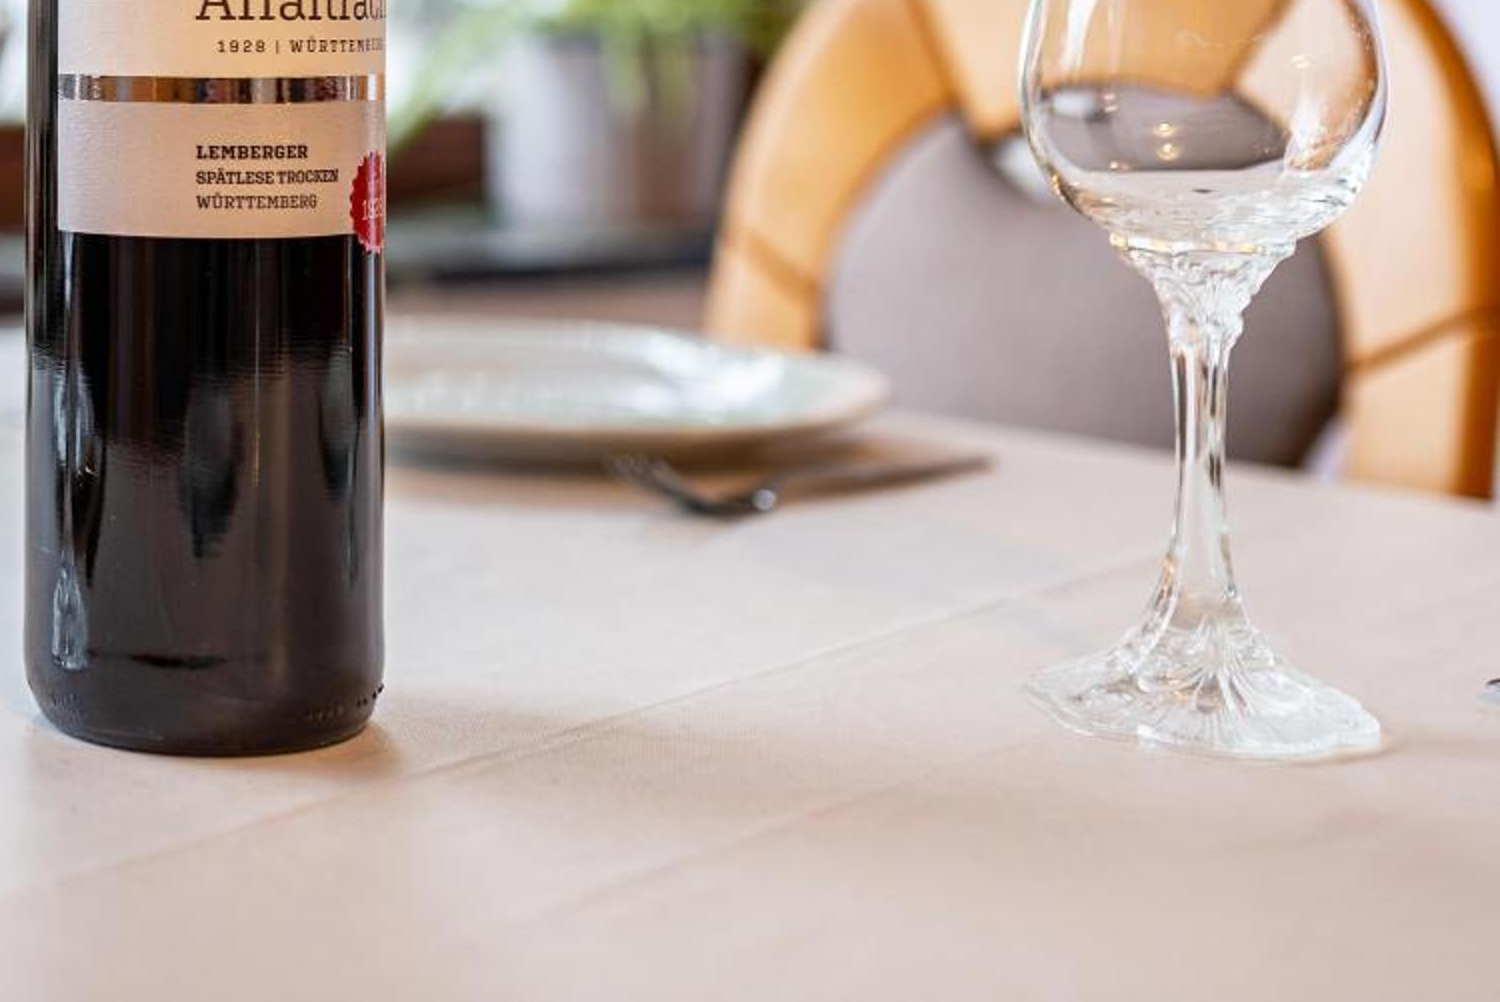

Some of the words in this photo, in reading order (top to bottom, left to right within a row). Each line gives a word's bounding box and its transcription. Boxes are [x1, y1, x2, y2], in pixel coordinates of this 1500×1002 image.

[217, 39, 267, 53] 1928
[196, 145, 308, 160] LEMBERGER
[195, 168, 275, 185] SPÄTLESE
[276, 168, 339, 183] TROCKEN
[196, 192, 318, 209] WÜRTTEMBERG
